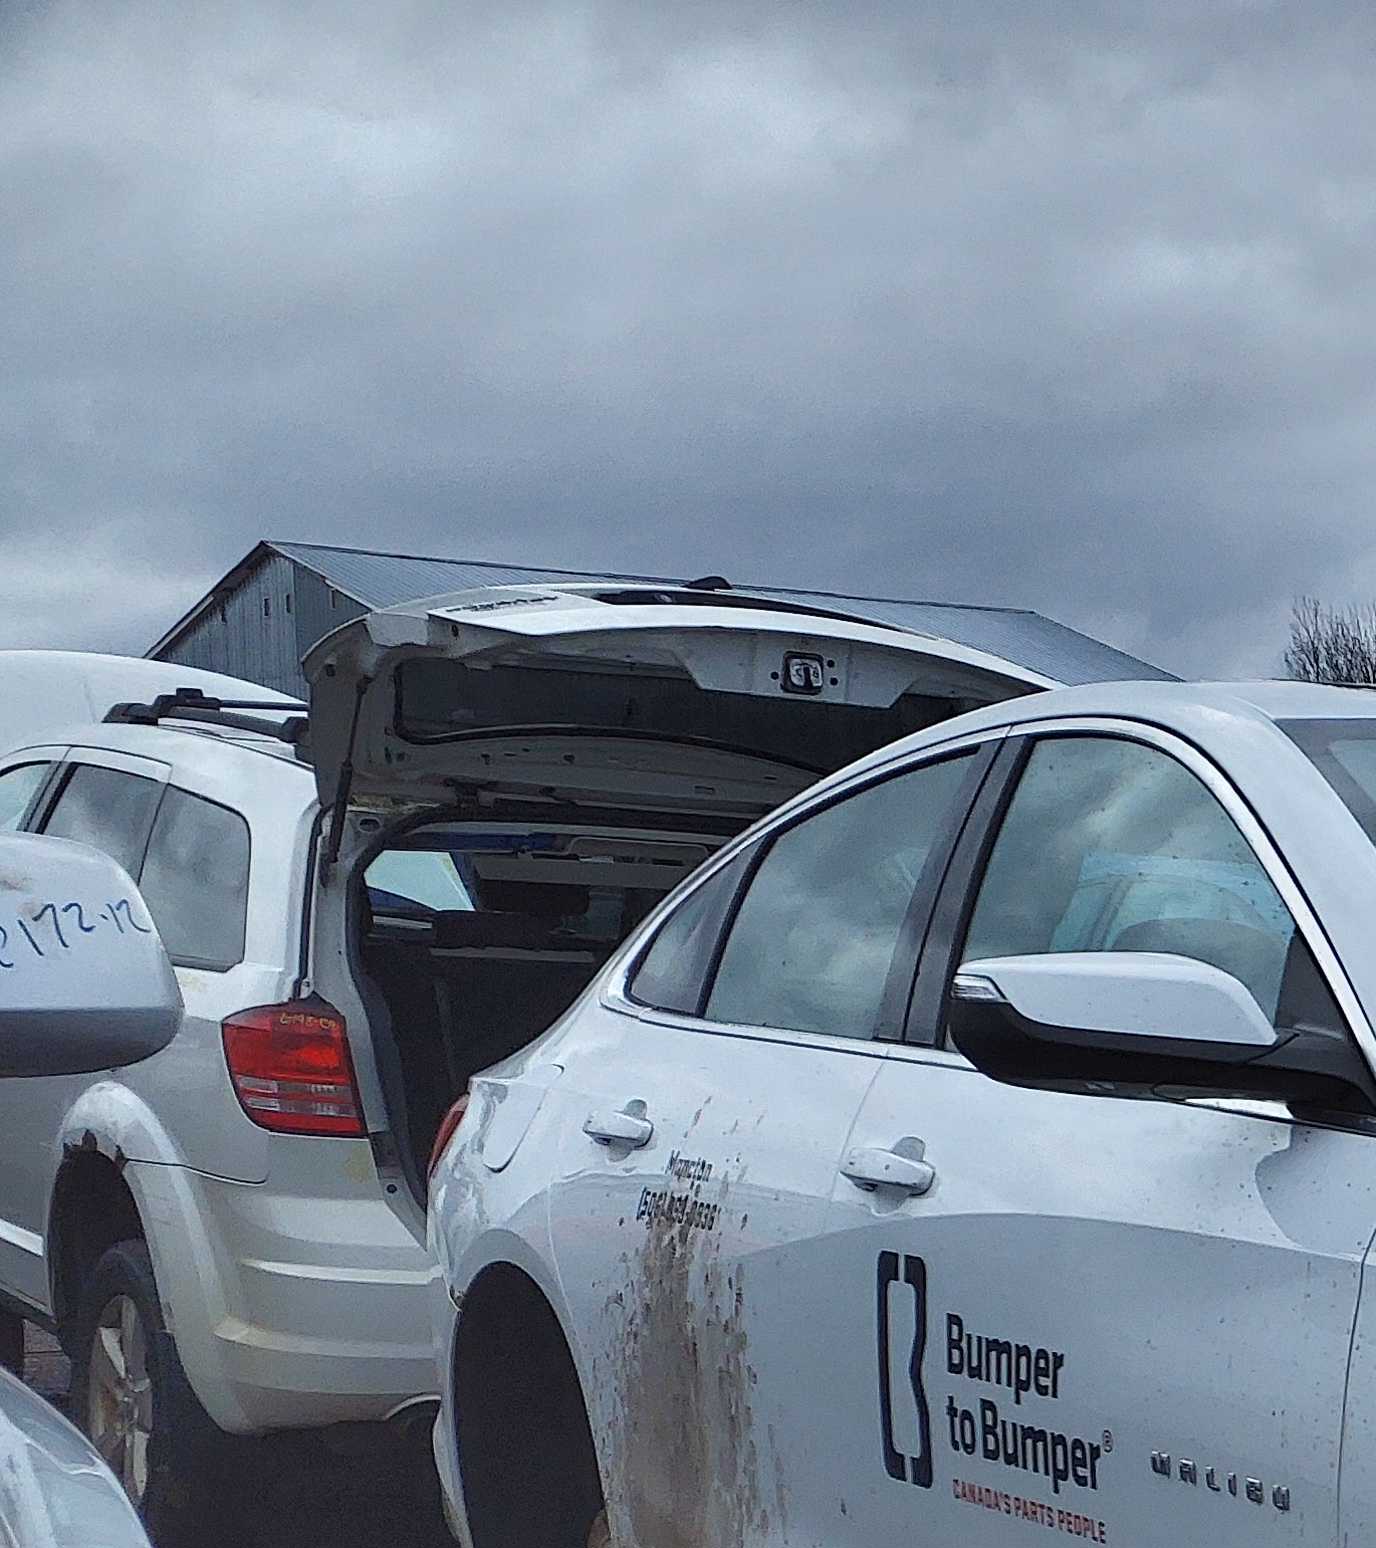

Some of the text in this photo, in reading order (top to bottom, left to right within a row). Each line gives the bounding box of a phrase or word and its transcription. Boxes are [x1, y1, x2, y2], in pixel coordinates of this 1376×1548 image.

[946, 1312, 1065, 1405] Bumper
[946, 1395, 977, 1456] to
[952, 1478, 1107, 1545] CANADA'S PARTS PEOPLE
[1150, 1449, 1292, 1512] MALIBU
